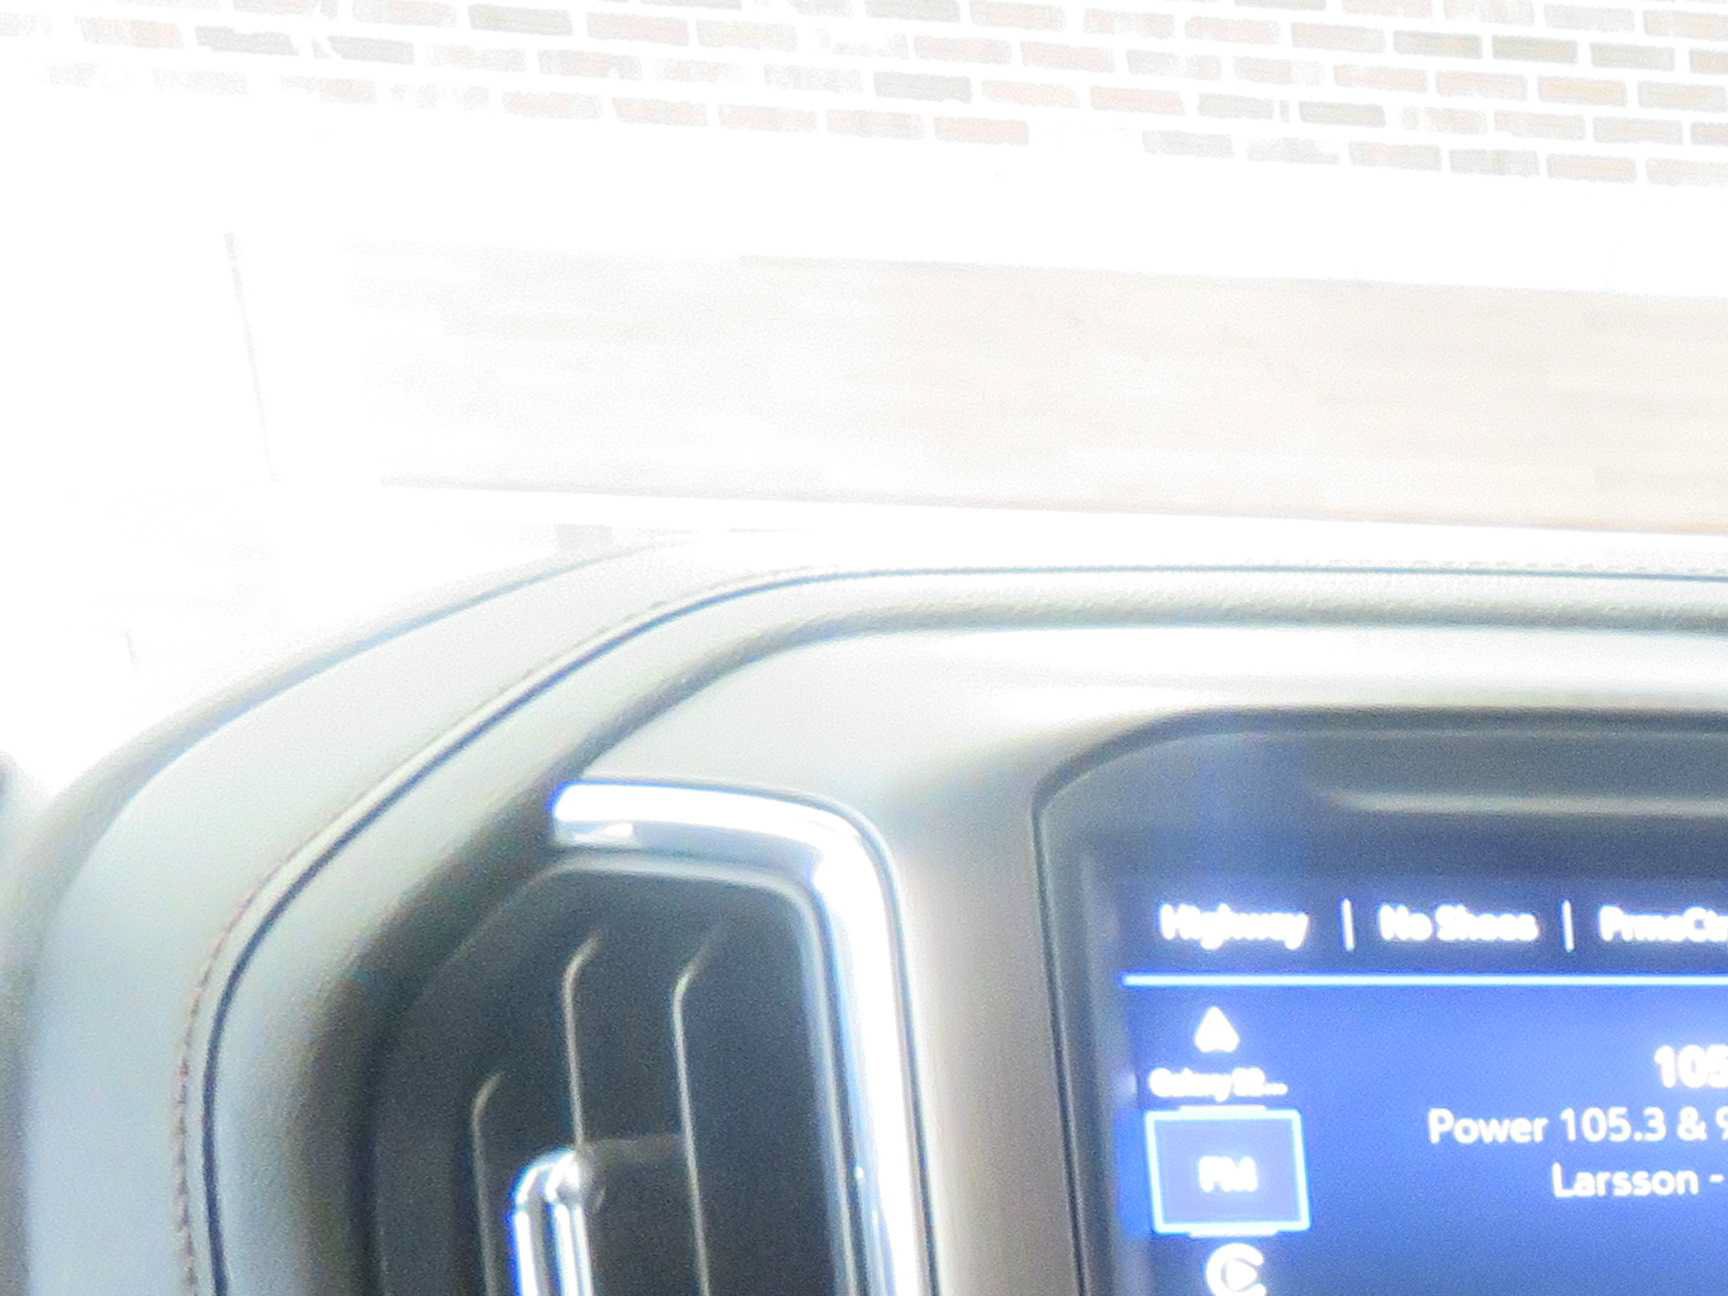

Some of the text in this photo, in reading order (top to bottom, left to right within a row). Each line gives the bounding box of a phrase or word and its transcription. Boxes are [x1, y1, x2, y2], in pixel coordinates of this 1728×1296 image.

[1378, 904, 1541, 942] No Shoes
[1427, 1107, 1549, 1144] Power
[1560, 1106, 1668, 1143] 105.3
[1677, 1106, 1708, 1142] &
[1552, 1162, 1699, 1198] Larsson
